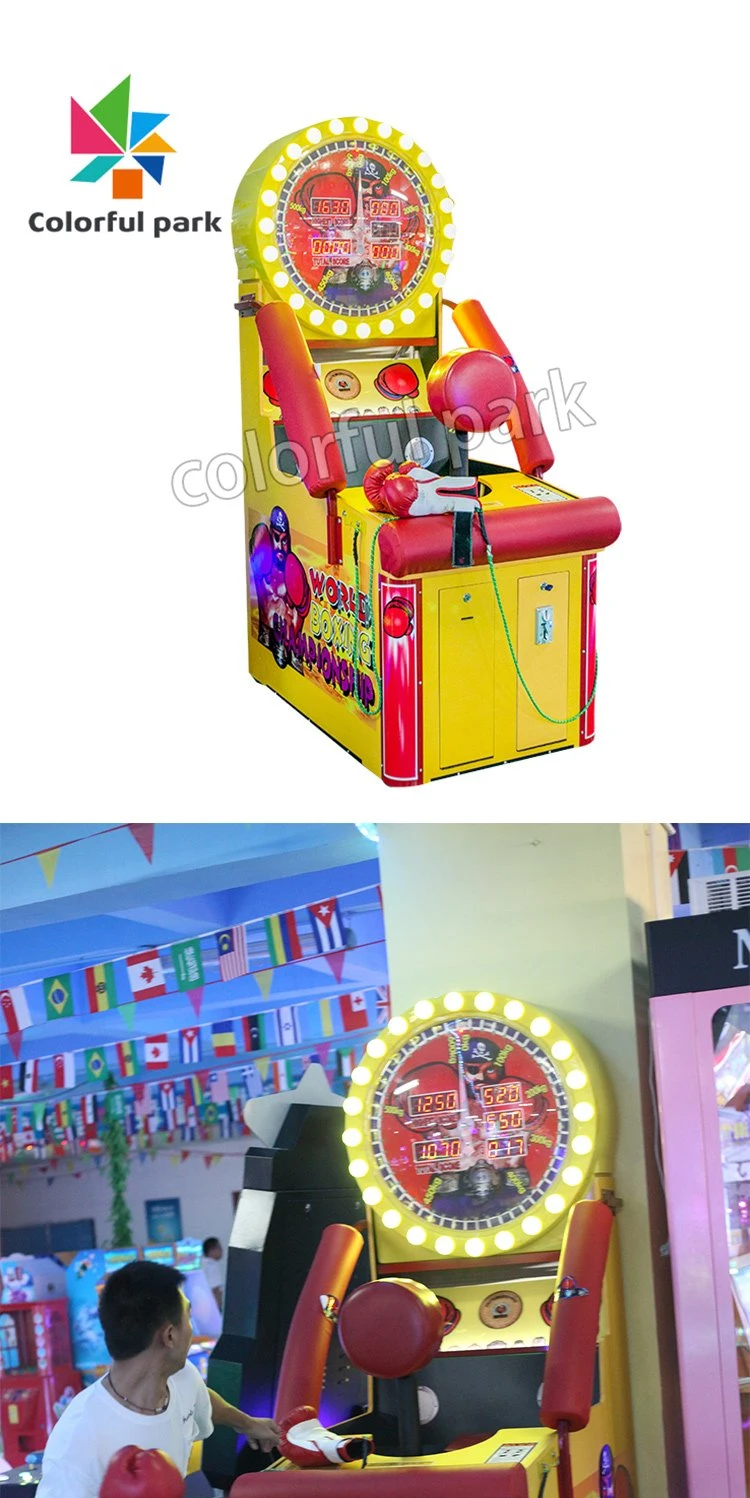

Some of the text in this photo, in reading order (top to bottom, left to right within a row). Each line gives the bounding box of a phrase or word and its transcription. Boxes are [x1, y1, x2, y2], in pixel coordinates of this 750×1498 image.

[309, 567, 371, 628] WORLD
[310, 600, 373, 670] BOXING
[417, 1092, 457, 1112] 1250
[483, 1085, 519, 1105] 520
[421, 1140, 461, 1160] 1070
